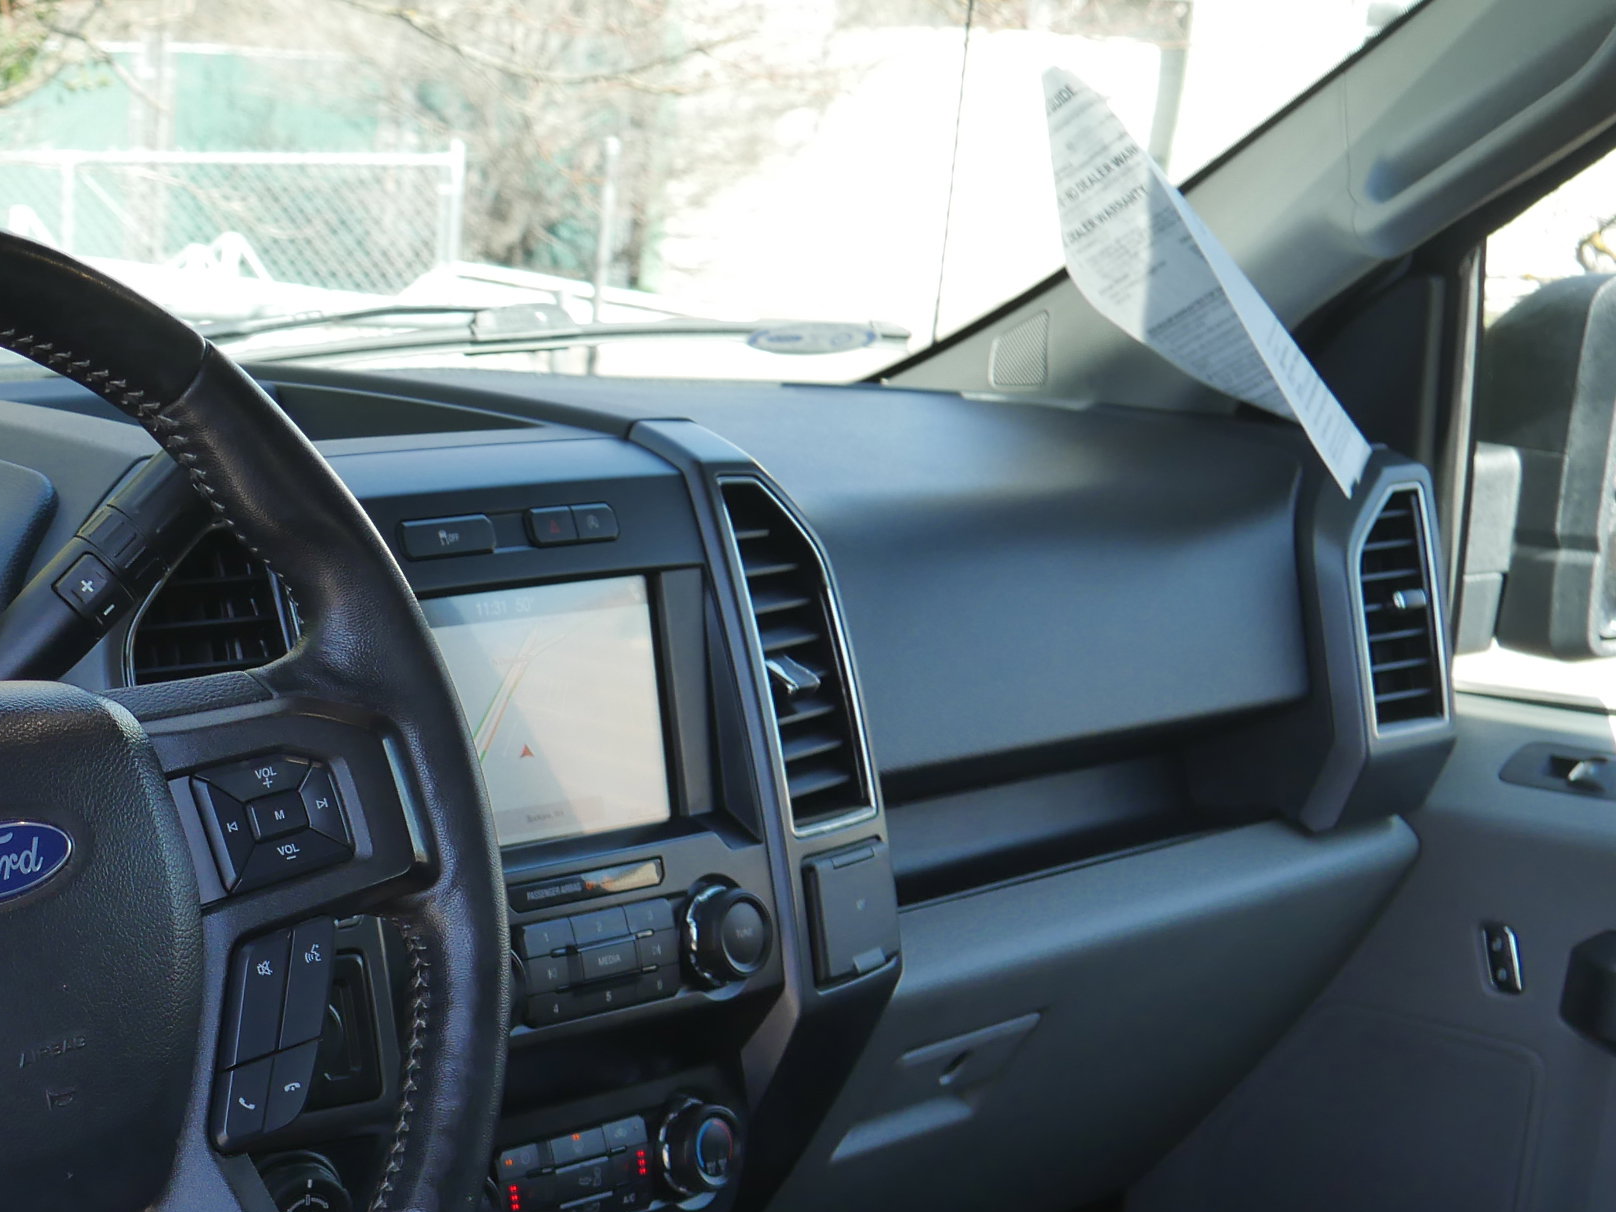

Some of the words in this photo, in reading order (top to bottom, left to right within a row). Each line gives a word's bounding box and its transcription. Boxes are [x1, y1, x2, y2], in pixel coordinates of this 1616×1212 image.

[1096, 184, 1148, 225] WARRANTY
[255, 766, 277, 779] VOL
[274, 810, 285, 820] M
[277, 843, 300, 856] VOL
[598, 954, 622, 966] MEDIA
